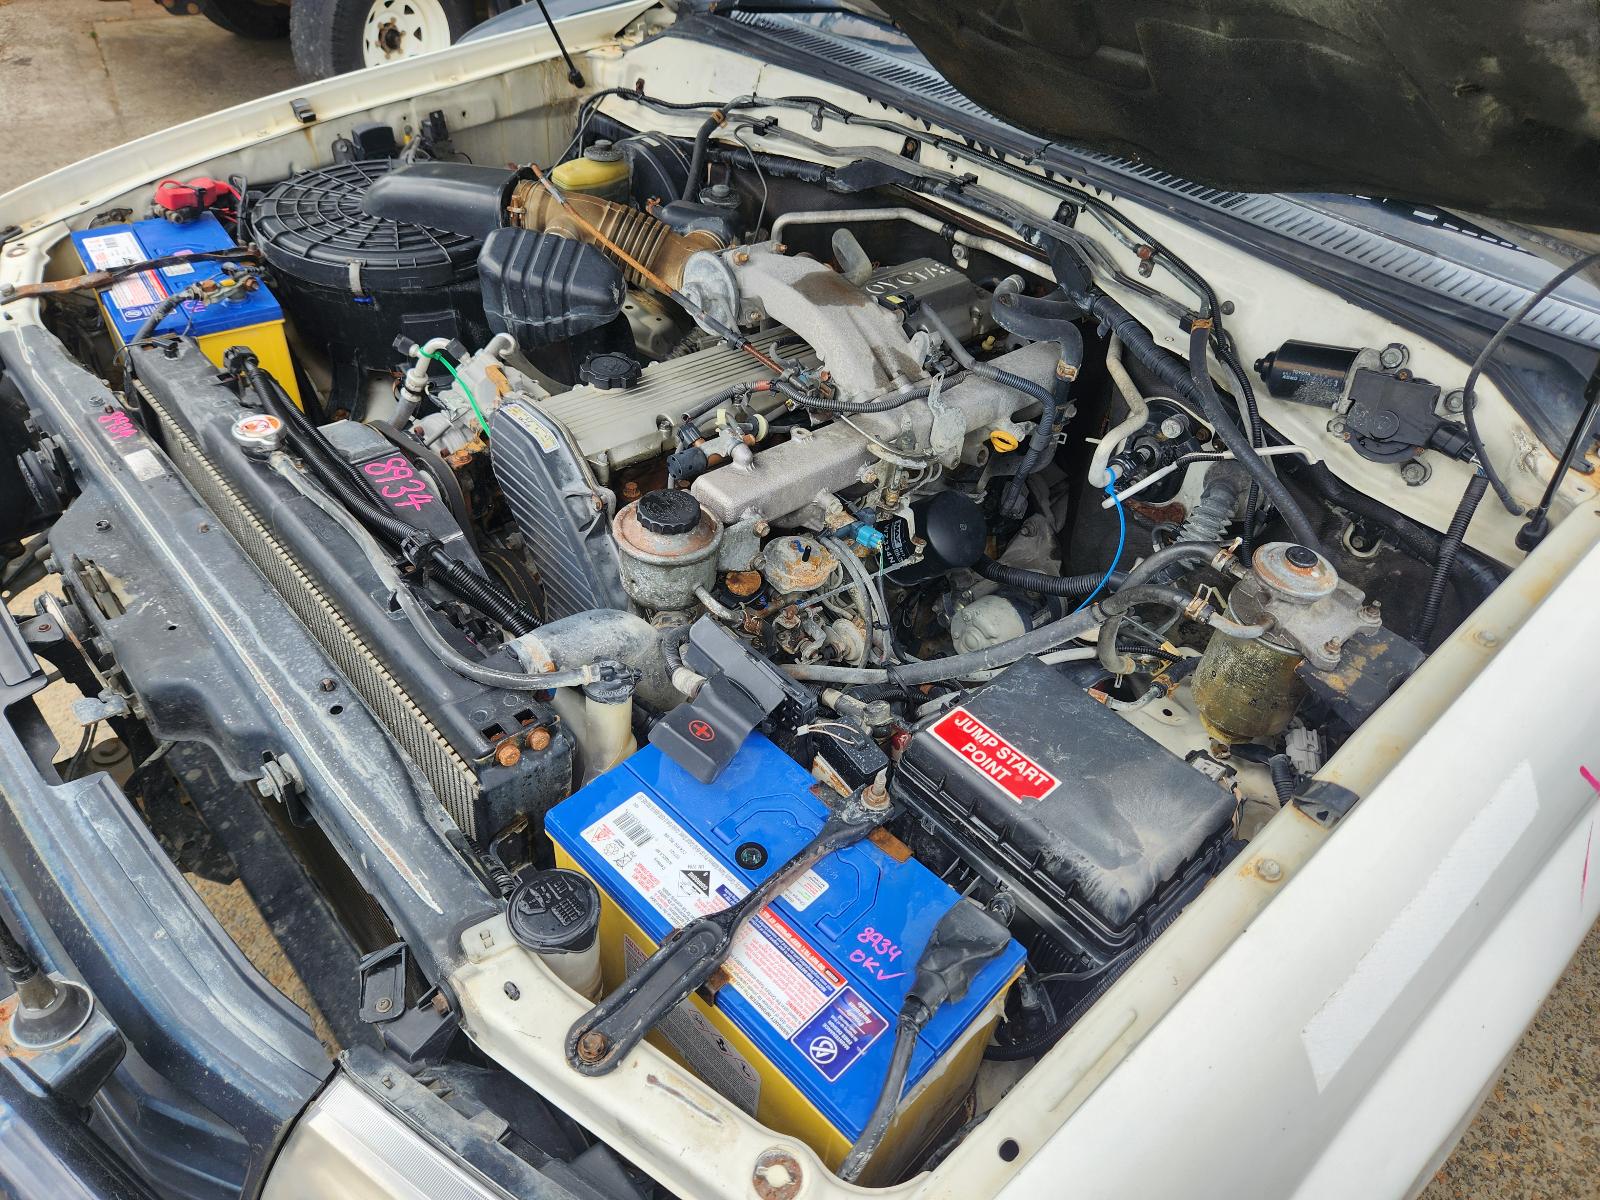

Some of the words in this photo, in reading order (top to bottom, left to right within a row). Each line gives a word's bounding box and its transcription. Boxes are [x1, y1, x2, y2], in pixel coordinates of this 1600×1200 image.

[364, 457, 433, 511] 8934
[954, 717, 998, 748] JUMP
[996, 746, 1050, 787] START
[960, 742, 1012, 781] POINT
[773, 921, 792, 939] UPRIGHT
[857, 927, 902, 963] 8934
[808, 954, 820, 965] NOT
[784, 1000, 807, 1022] WARNING
[846, 1001, 872, 1025] Australian
[855, 1000, 872, 1016] Made
[820, 1022, 851, 1050] MAINTENANCE
[826, 1019, 843, 1036] DESIGN
[840, 1032, 853, 1045] FREE
